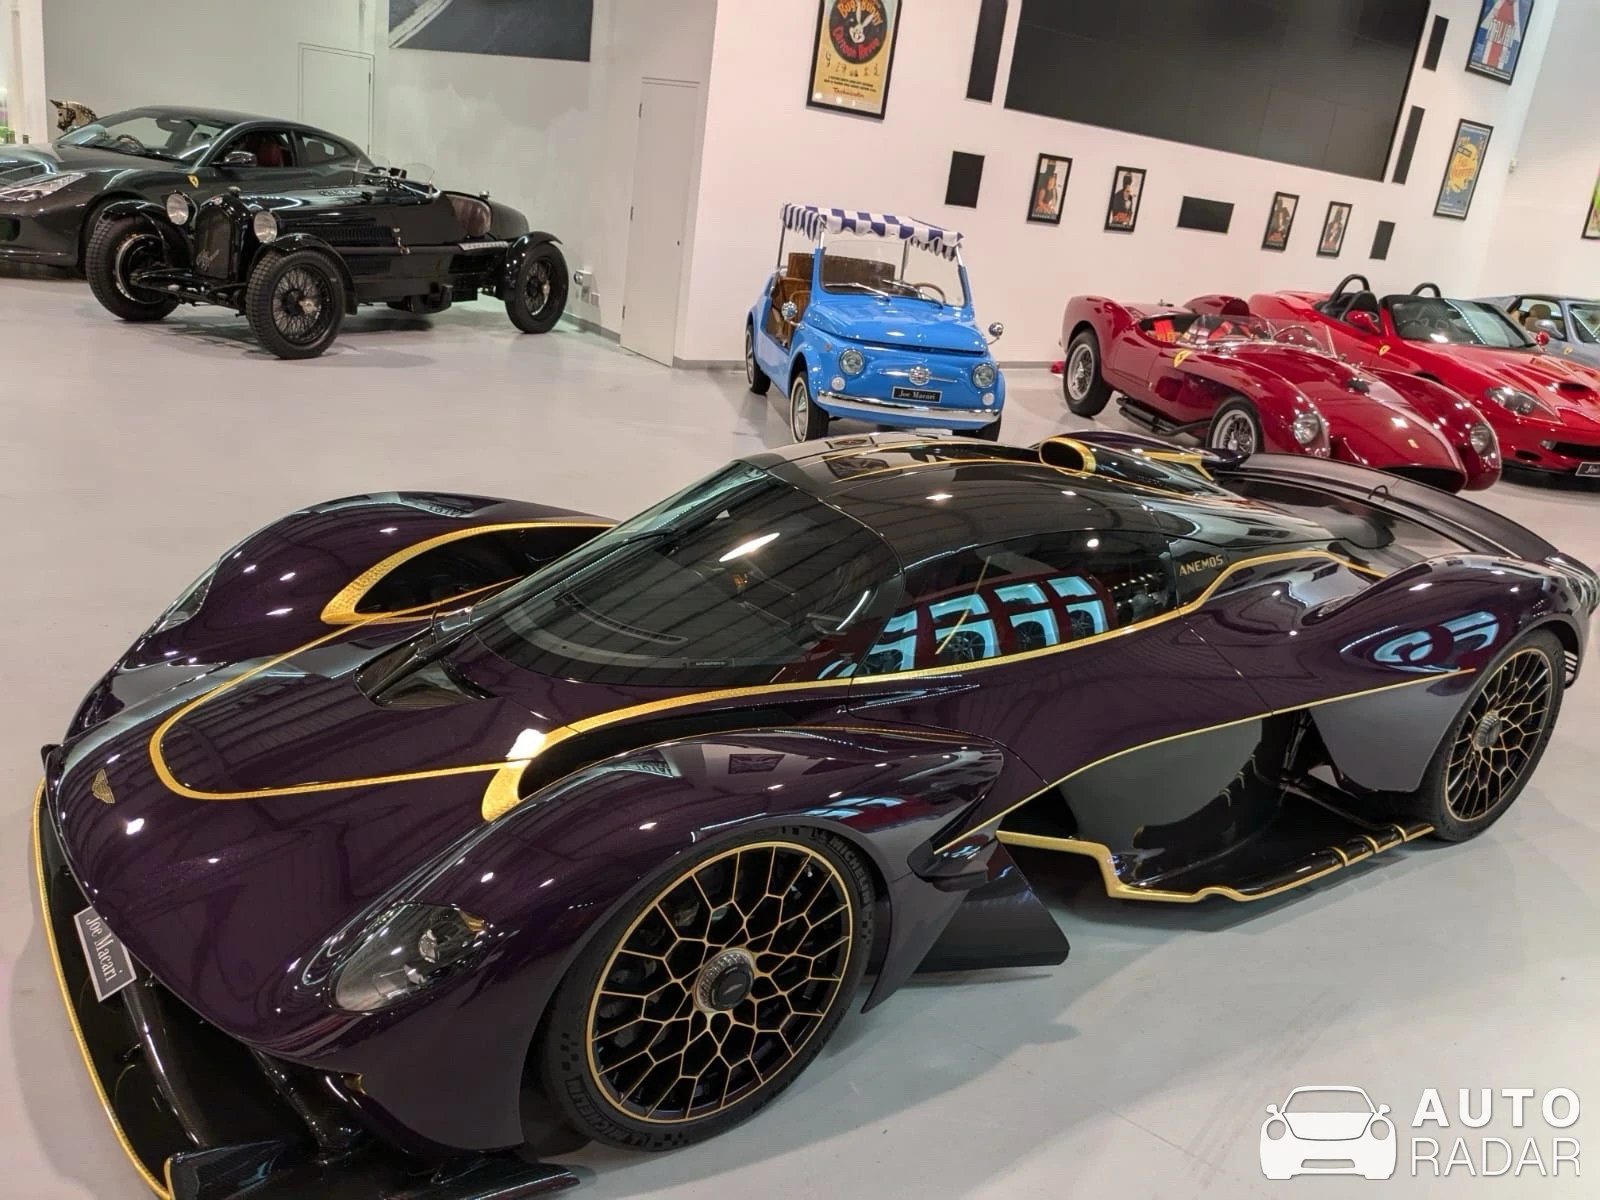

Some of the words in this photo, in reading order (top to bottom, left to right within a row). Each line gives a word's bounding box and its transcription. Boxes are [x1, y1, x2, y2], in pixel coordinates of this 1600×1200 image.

[898, 389, 910, 398] Joe
[912, 391, 937, 401] Macari
[1179, 554, 1224, 577] ANEMOS
[829, 835, 874, 907] MICHELIN
[85, 916, 103, 937] Joe
[94, 932, 123, 982] Macari
